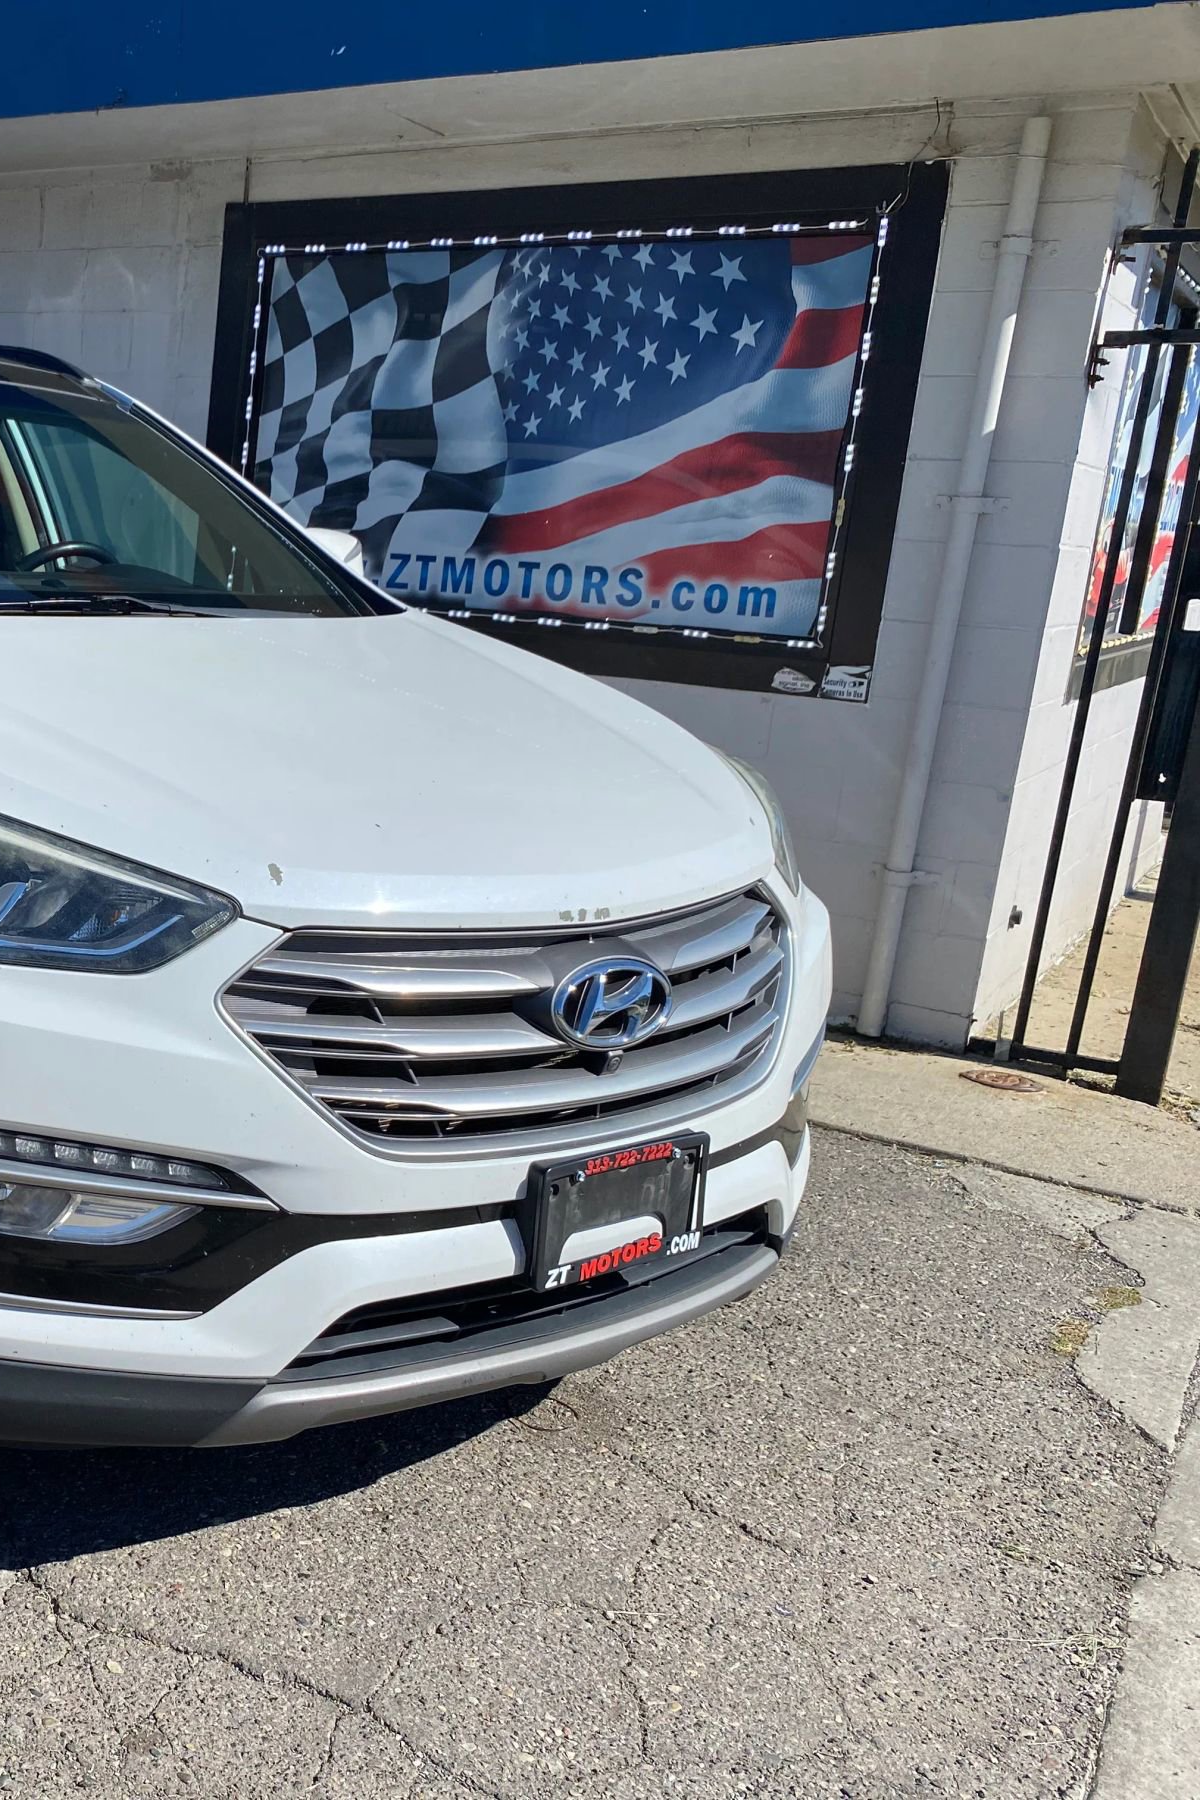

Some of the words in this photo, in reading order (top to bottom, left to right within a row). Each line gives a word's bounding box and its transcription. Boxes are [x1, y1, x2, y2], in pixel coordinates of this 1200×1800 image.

[363, 553, 777, 618] .ZTMOTORS.com
[544, 1264, 572, 1289] ZT
[579, 1231, 662, 1282] MOTORS
[666, 1231, 701, 1256] .COM
